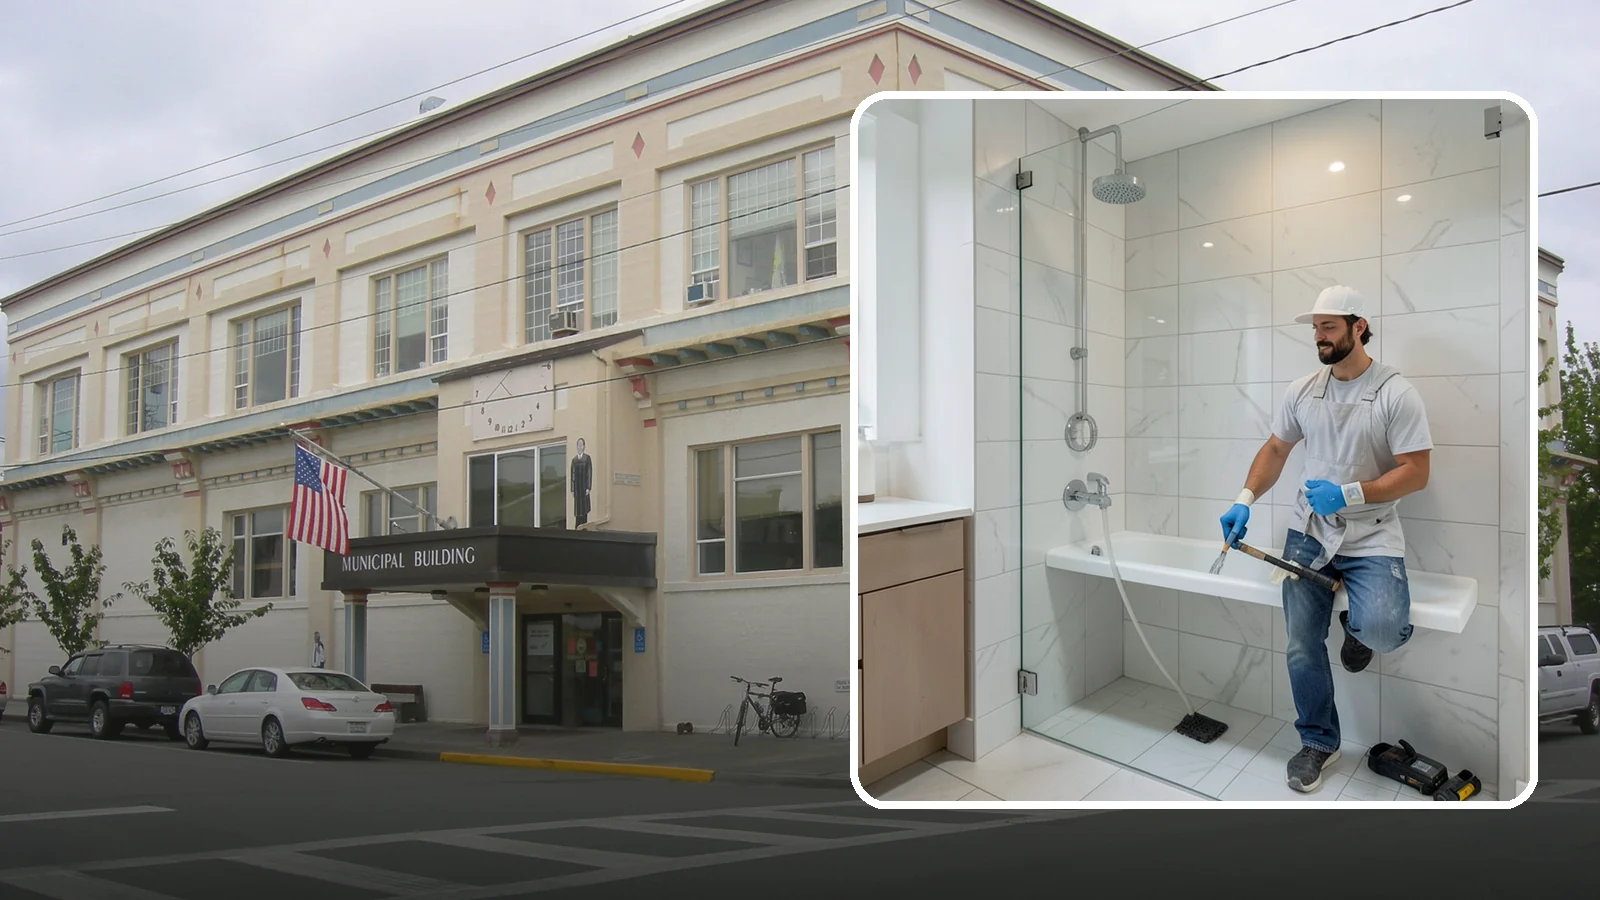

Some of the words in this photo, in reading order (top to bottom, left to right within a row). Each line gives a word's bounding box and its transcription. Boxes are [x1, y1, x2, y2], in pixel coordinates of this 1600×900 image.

[481, 407, 485, 415] 8
[488, 418, 492, 426] 9
[521, 420, 525, 428] 2
[507, 425, 513, 433] 12
[342, 552, 405, 572] MUNICIPAL
[414, 546, 475, 567] BUILDING
